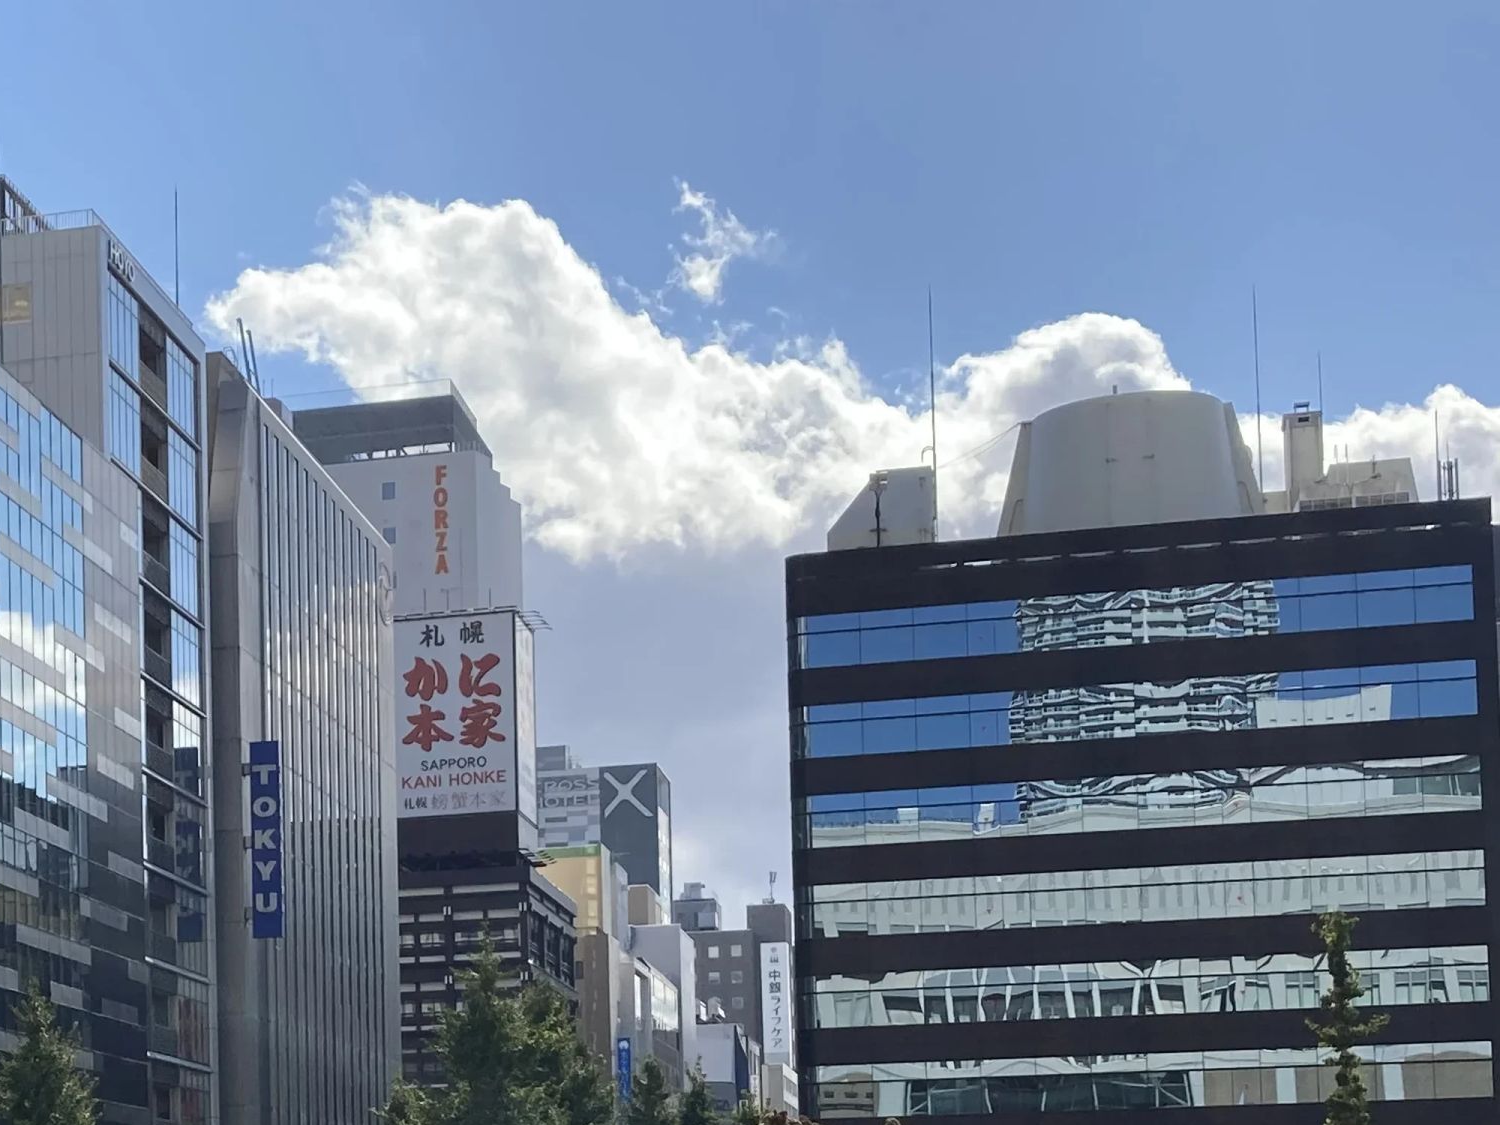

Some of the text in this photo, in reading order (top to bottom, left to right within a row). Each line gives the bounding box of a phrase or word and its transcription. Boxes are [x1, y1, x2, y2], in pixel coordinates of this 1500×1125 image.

[107, 239, 136, 283] HOYO
[432, 464, 450, 575] FORZA
[419, 620, 485, 648] 札幌
[402, 652, 503, 702] かに
[401, 699, 507, 753] 本家
[401, 769, 507, 790] KANI HONKE
[420, 755, 488, 772] SAPPORO
[251, 763, 279, 913] TOKYU
